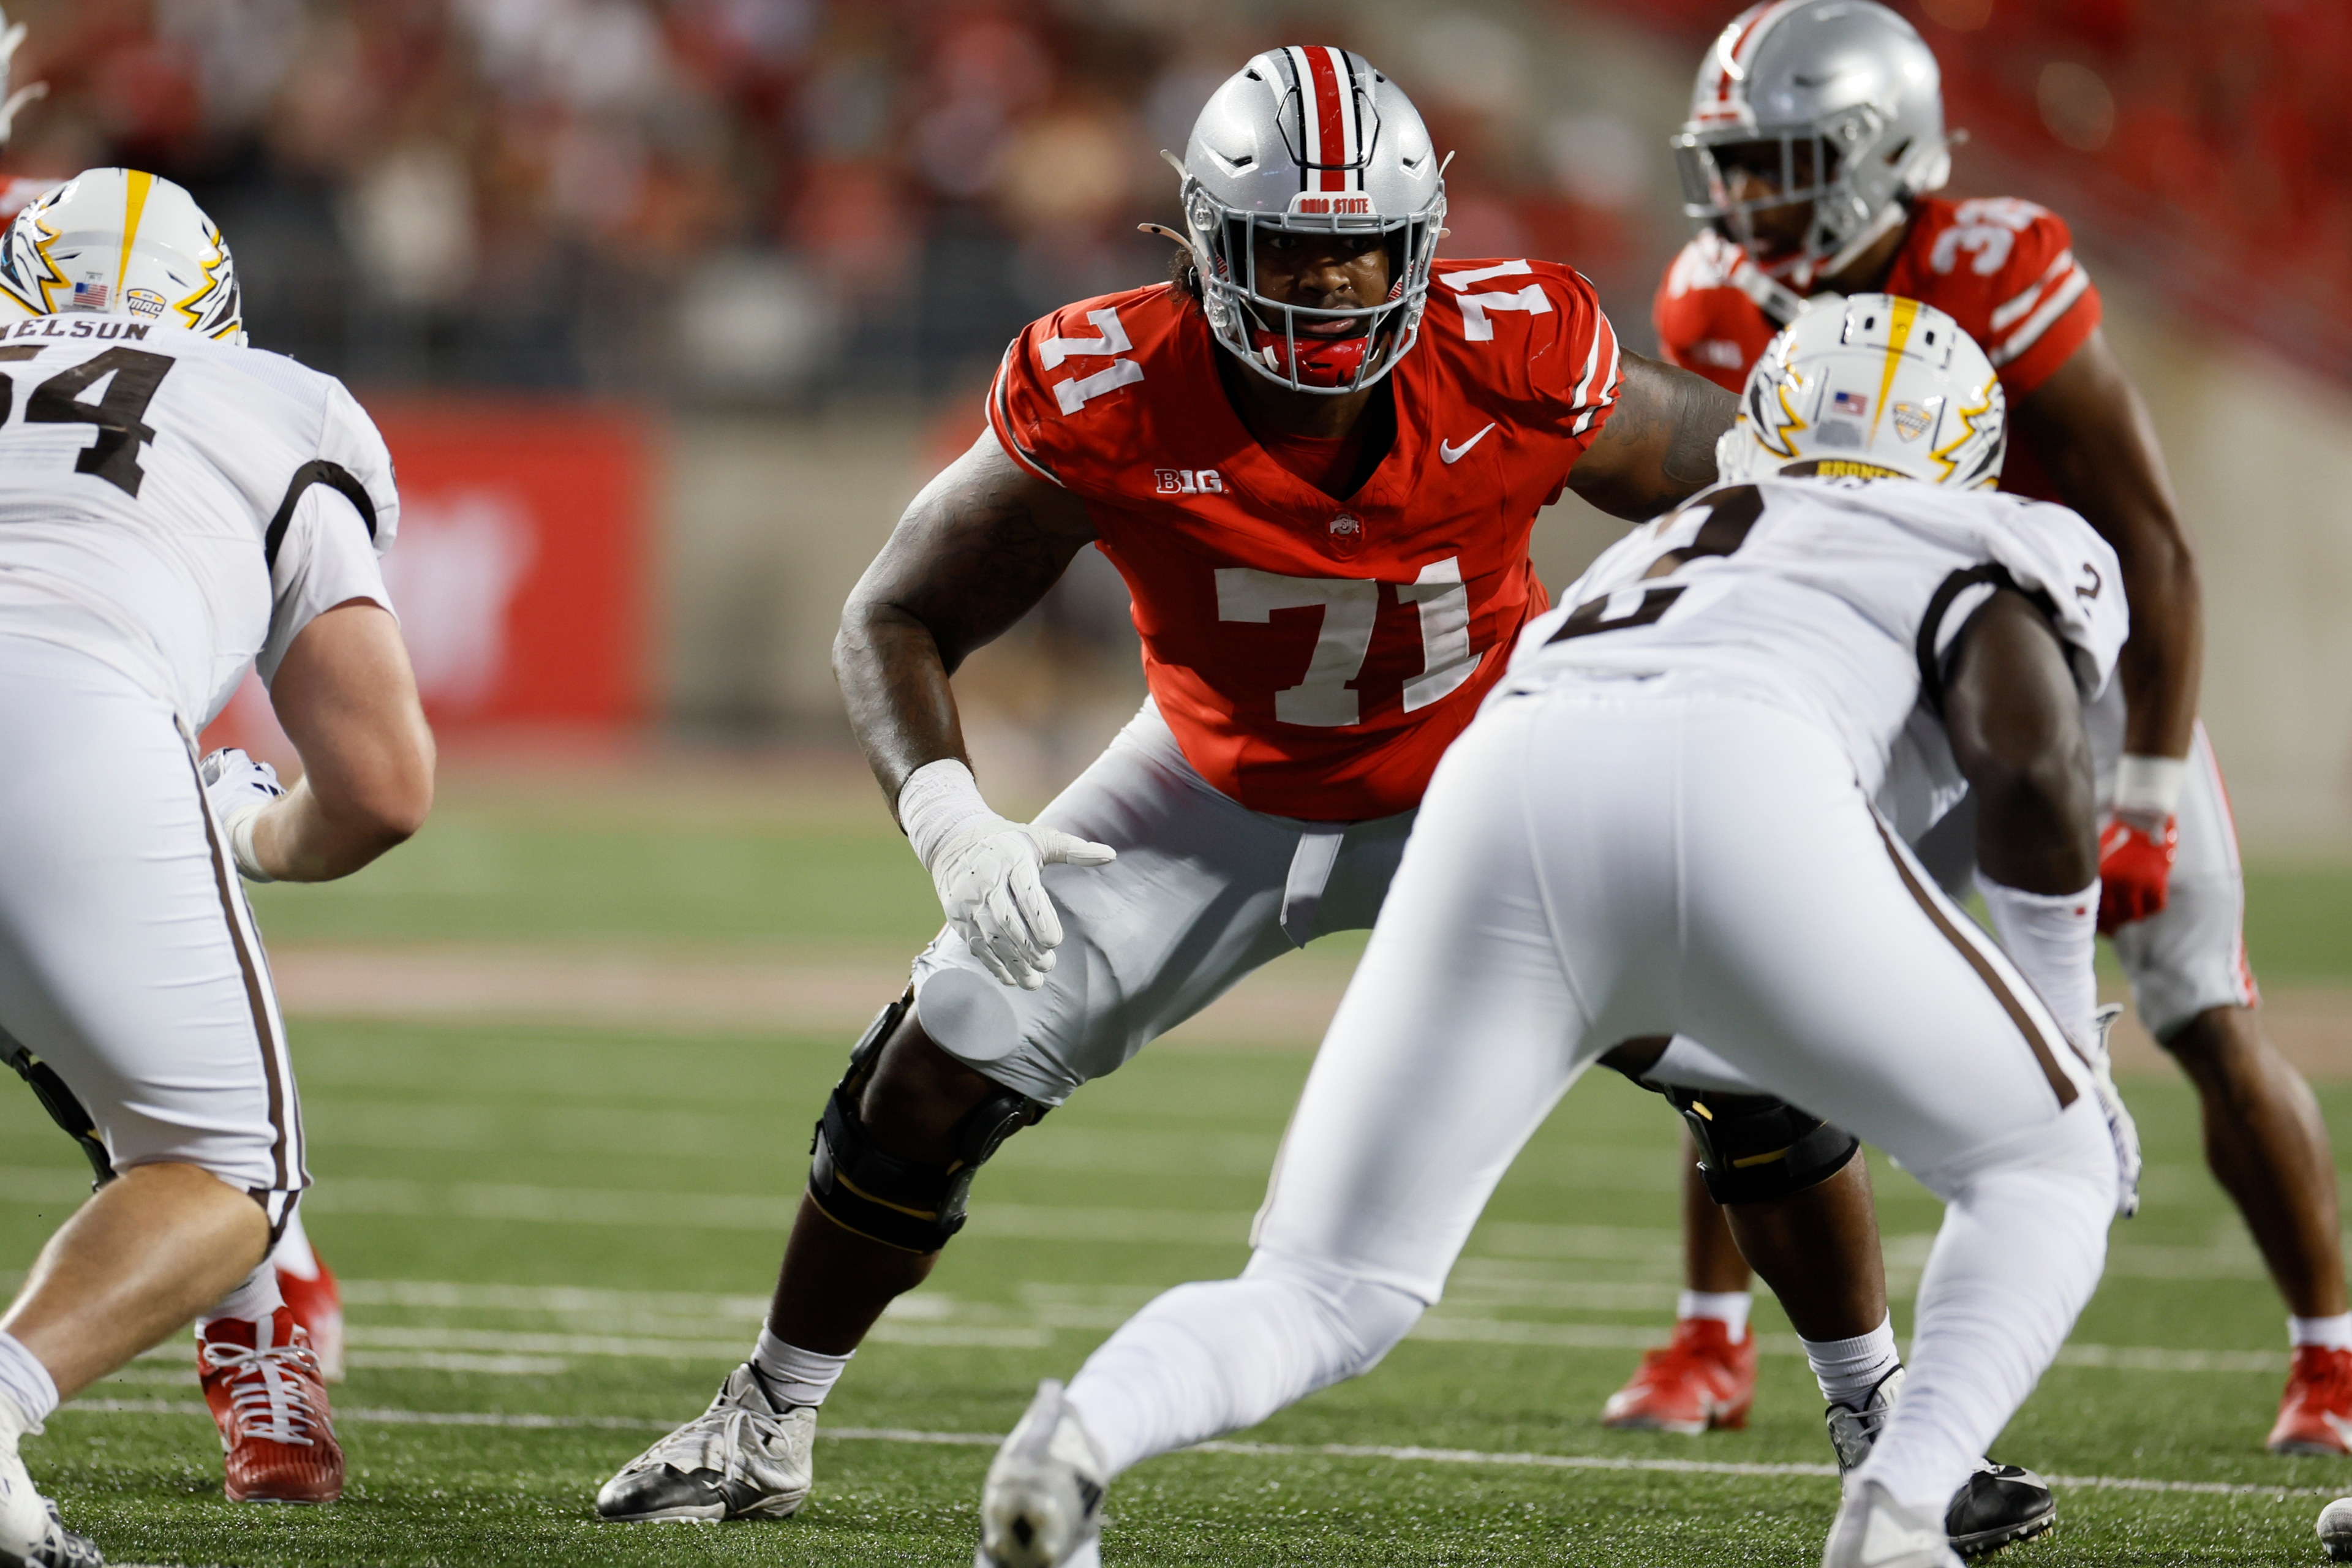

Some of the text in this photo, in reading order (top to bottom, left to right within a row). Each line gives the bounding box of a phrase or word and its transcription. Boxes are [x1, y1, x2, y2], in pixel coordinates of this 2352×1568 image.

[1300, 198, 1368, 214] OHIO STATE
[129, 297, 163, 315] MAC
[1438, 258, 1553, 341] 71
[1038, 306, 1145, 417] 71
[1542, 484, 1765, 646] 2
[1213, 556, 1482, 726] 71
